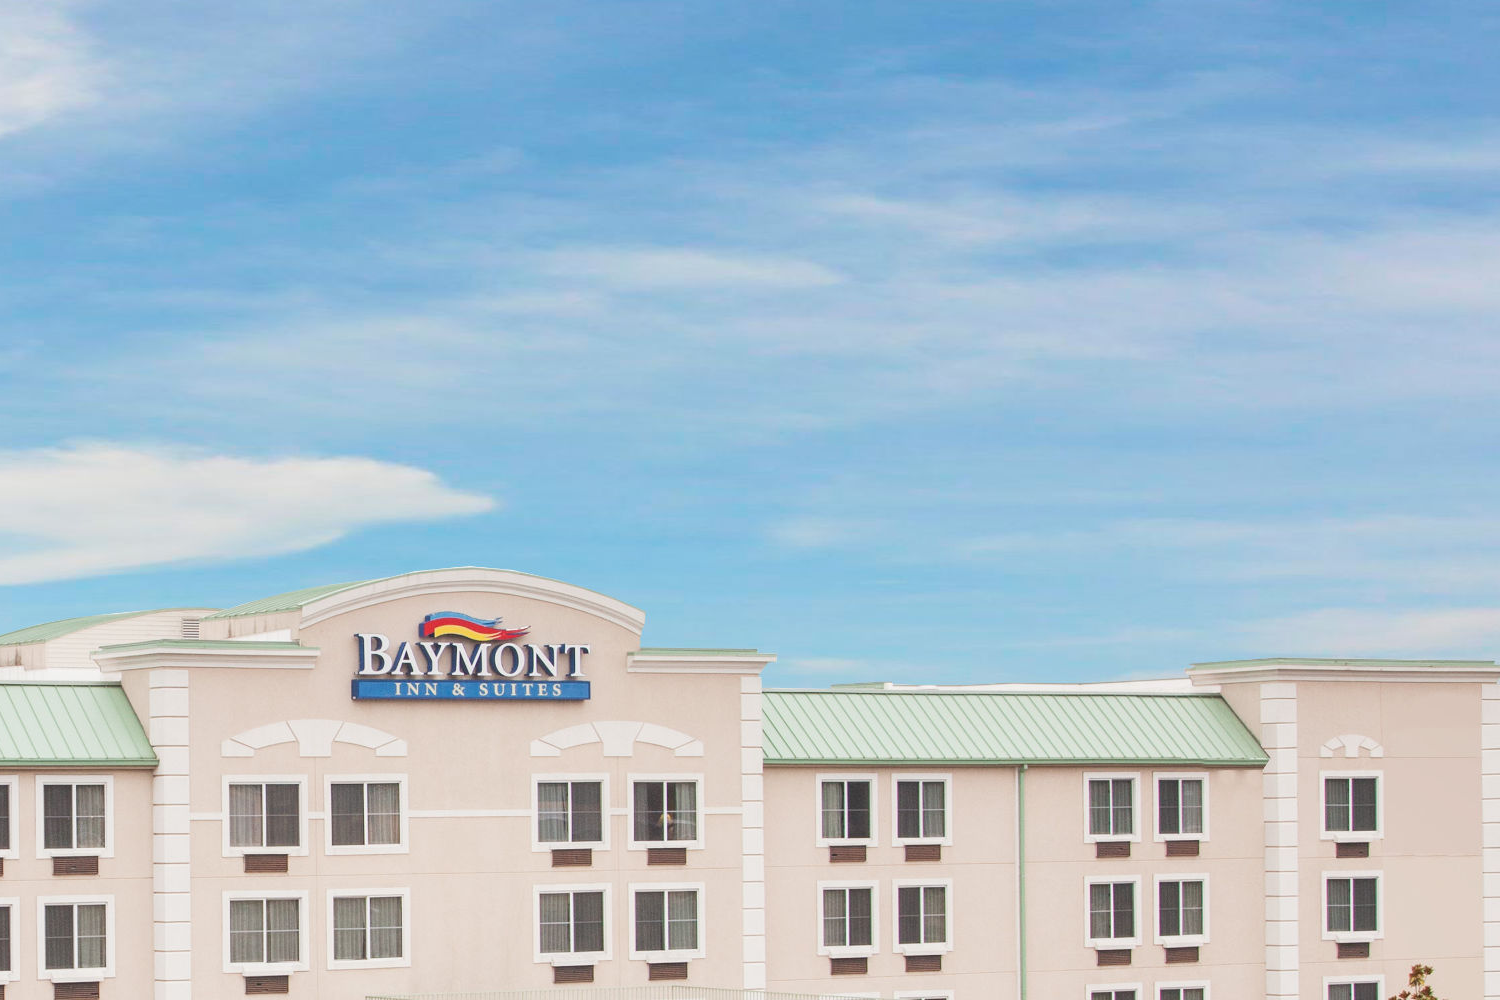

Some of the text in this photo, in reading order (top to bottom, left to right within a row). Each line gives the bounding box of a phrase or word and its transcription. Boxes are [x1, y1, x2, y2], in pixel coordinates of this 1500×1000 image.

[354, 633, 591, 677] BAYMONT
[394, 682, 562, 697] INN & SUITES
